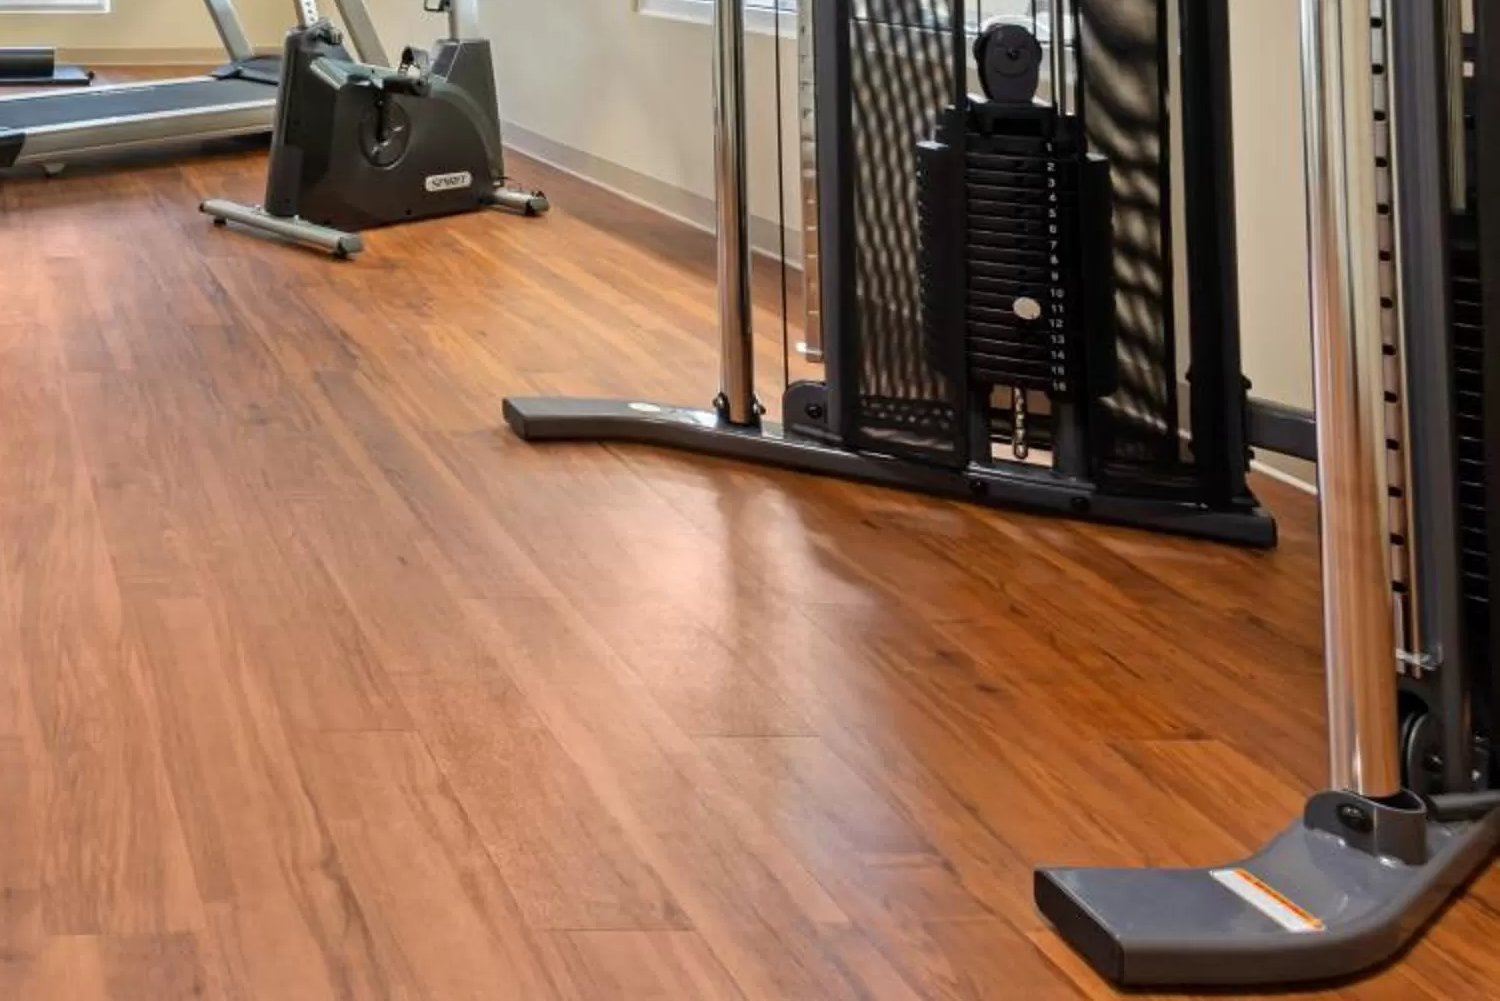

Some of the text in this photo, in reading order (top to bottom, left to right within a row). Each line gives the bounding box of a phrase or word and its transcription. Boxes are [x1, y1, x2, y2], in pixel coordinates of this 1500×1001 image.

[1047, 162, 1056, 172] 2
[1047, 177, 1056, 188] 3
[1048, 240, 1058, 251] 7
[1050, 288, 1065, 299] 10
[1049, 318, 1064, 328] 12
